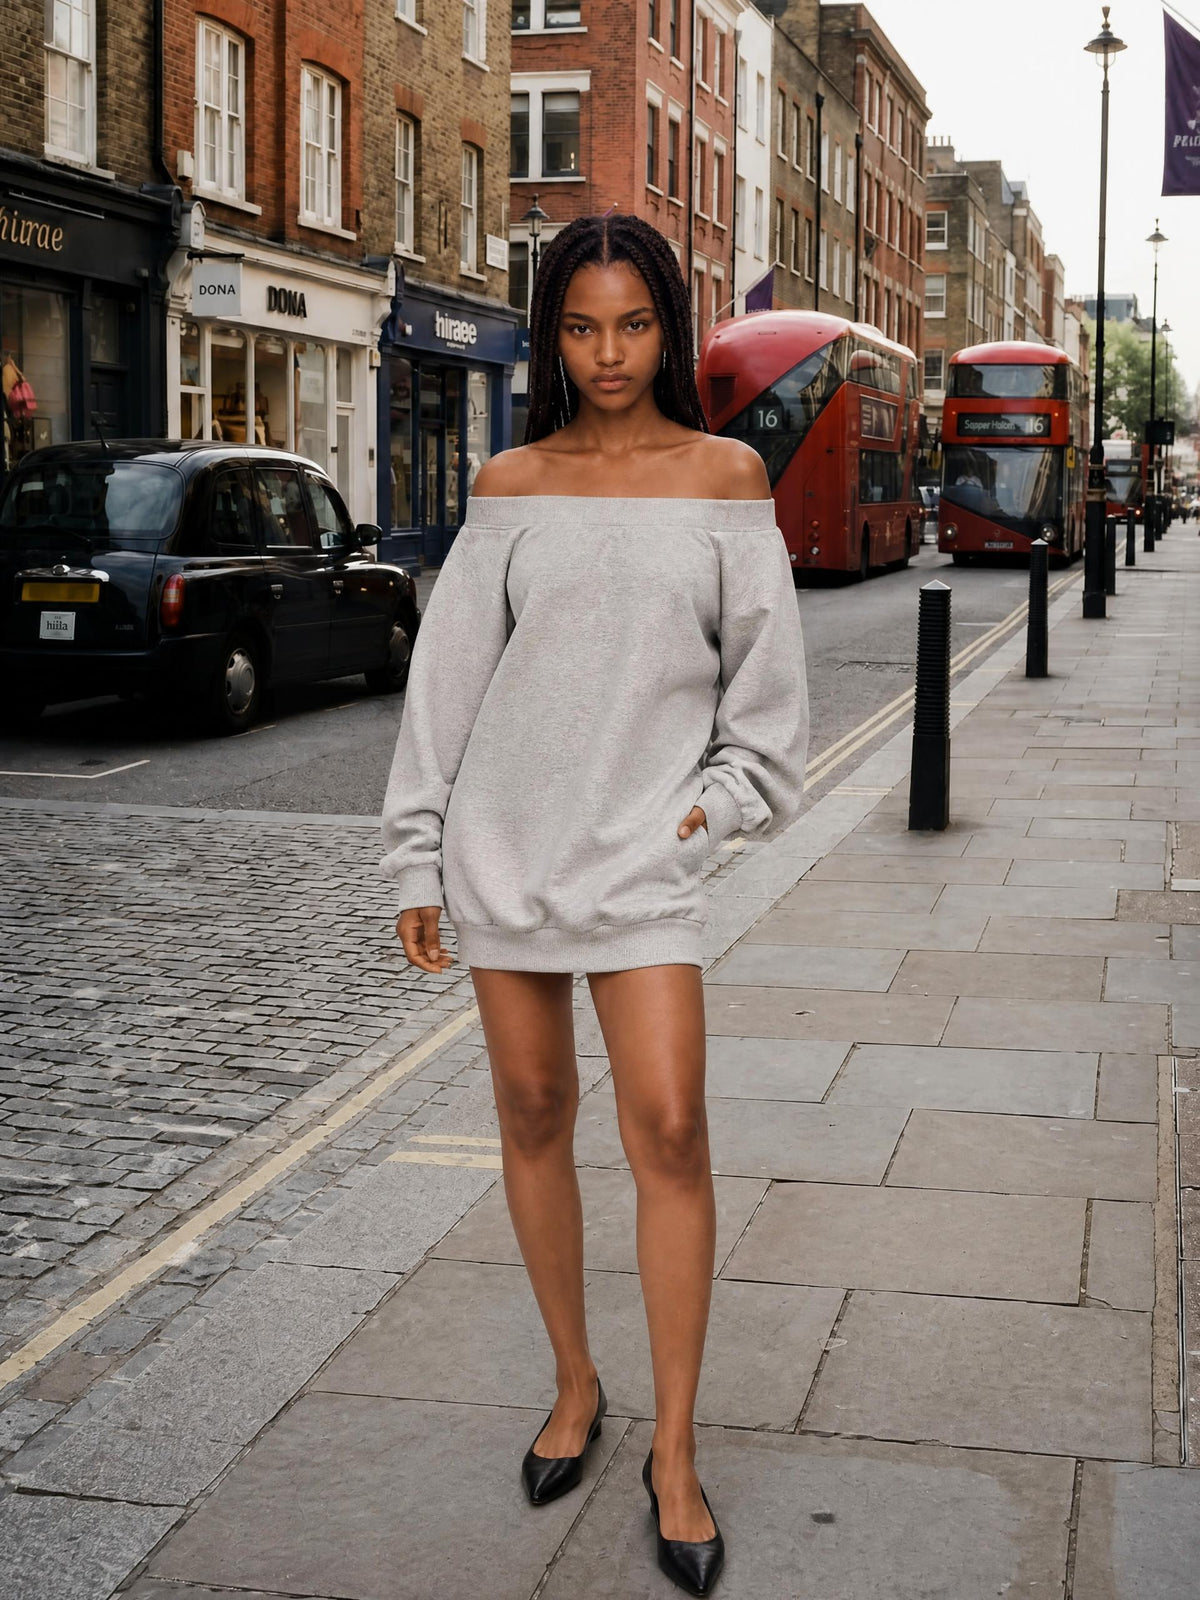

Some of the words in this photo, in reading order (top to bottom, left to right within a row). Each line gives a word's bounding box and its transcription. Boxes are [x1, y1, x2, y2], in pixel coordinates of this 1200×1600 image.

[199, 284, 236, 295] DONA
[267, 285, 307, 318] DONA
[435, 310, 478, 345] hiraee
[758, 409, 778, 428] 16
